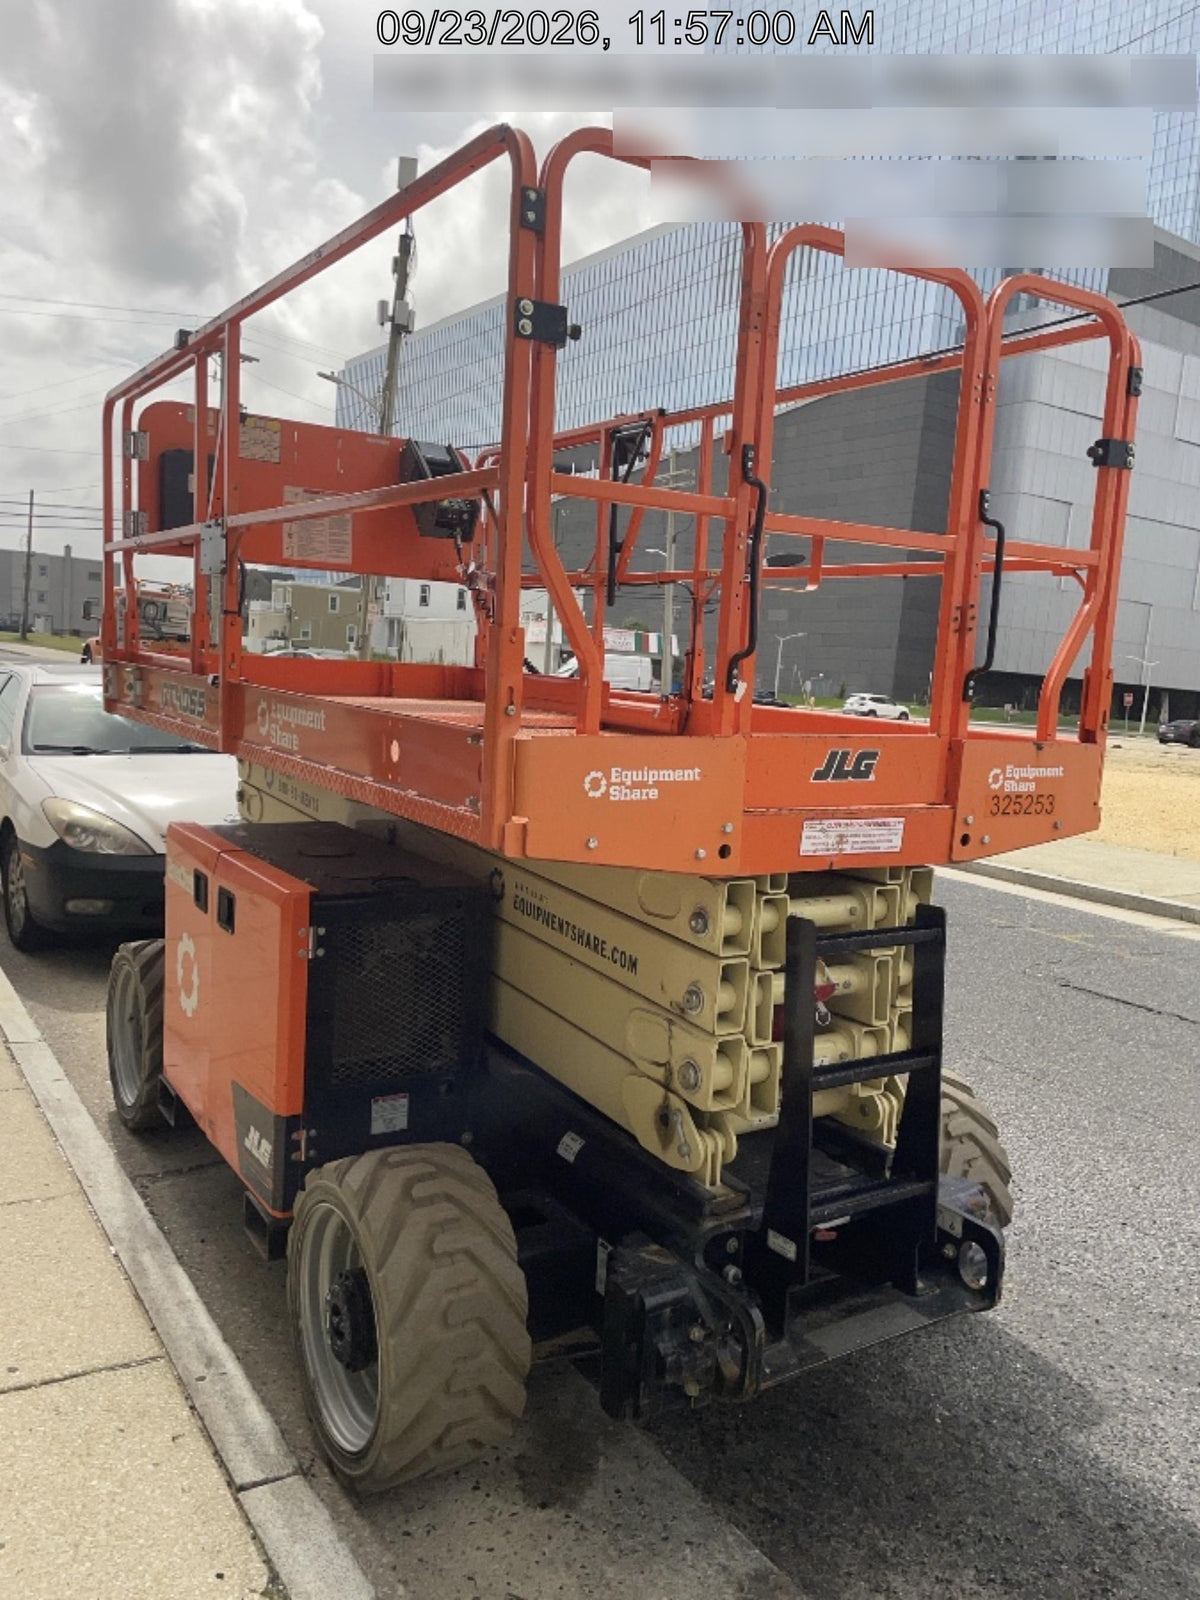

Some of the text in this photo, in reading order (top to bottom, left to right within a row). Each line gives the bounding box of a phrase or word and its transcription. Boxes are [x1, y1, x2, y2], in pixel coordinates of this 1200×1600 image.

[610, 766, 702, 786] Equipment
[809, 750, 881, 783] JLG
[1005, 764, 1065, 779] Equipment
[609, 785, 659, 801] Share
[1003, 780, 1036, 792] Share
[989, 793, 1056, 817] 325253
[512, 894, 639, 977] EQUIPMENTSHARE.COM
[244, 1124, 273, 1169] JLG
